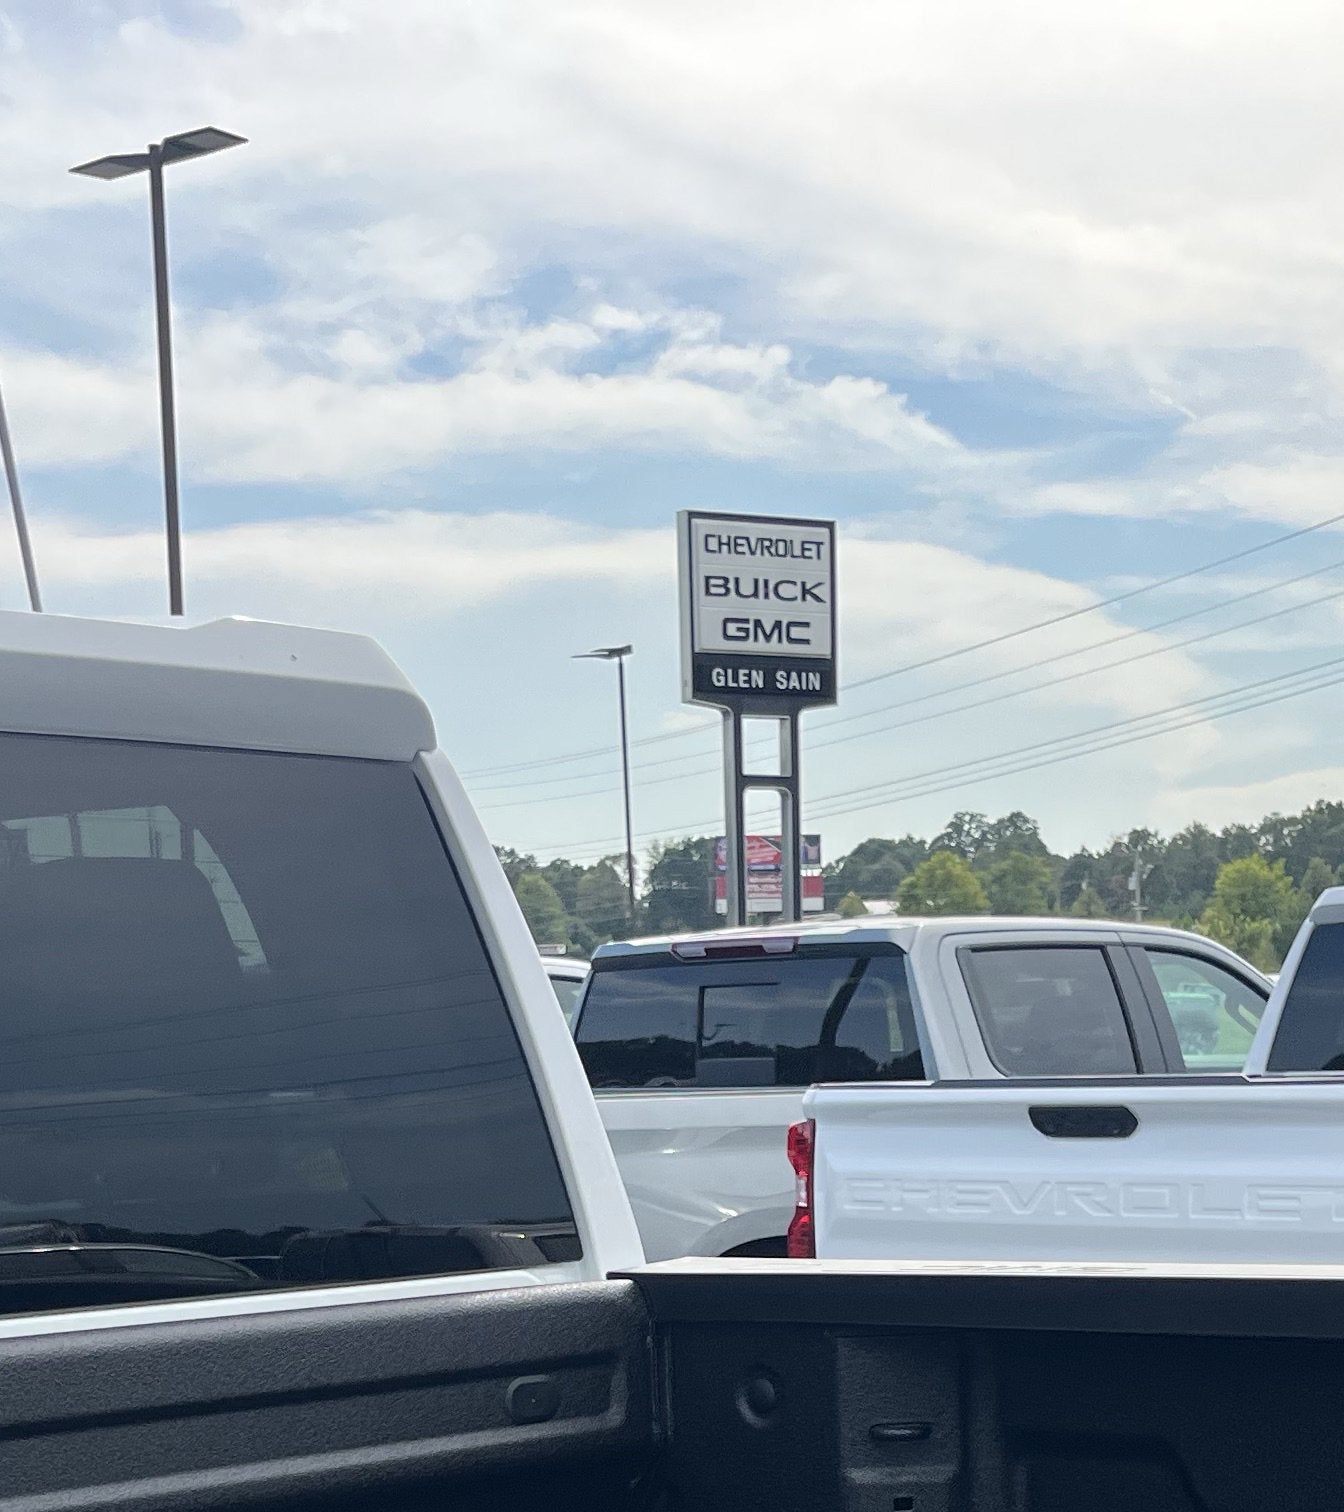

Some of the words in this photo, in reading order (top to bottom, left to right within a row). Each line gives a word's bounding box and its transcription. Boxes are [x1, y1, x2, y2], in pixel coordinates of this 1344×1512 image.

[703, 532, 825, 560] CHEVROLET
[703, 575, 827, 604] BUICK
[722, 617, 812, 645] GMC
[711, 667, 765, 689] GLEN
[775, 670, 822, 691] SAIN
